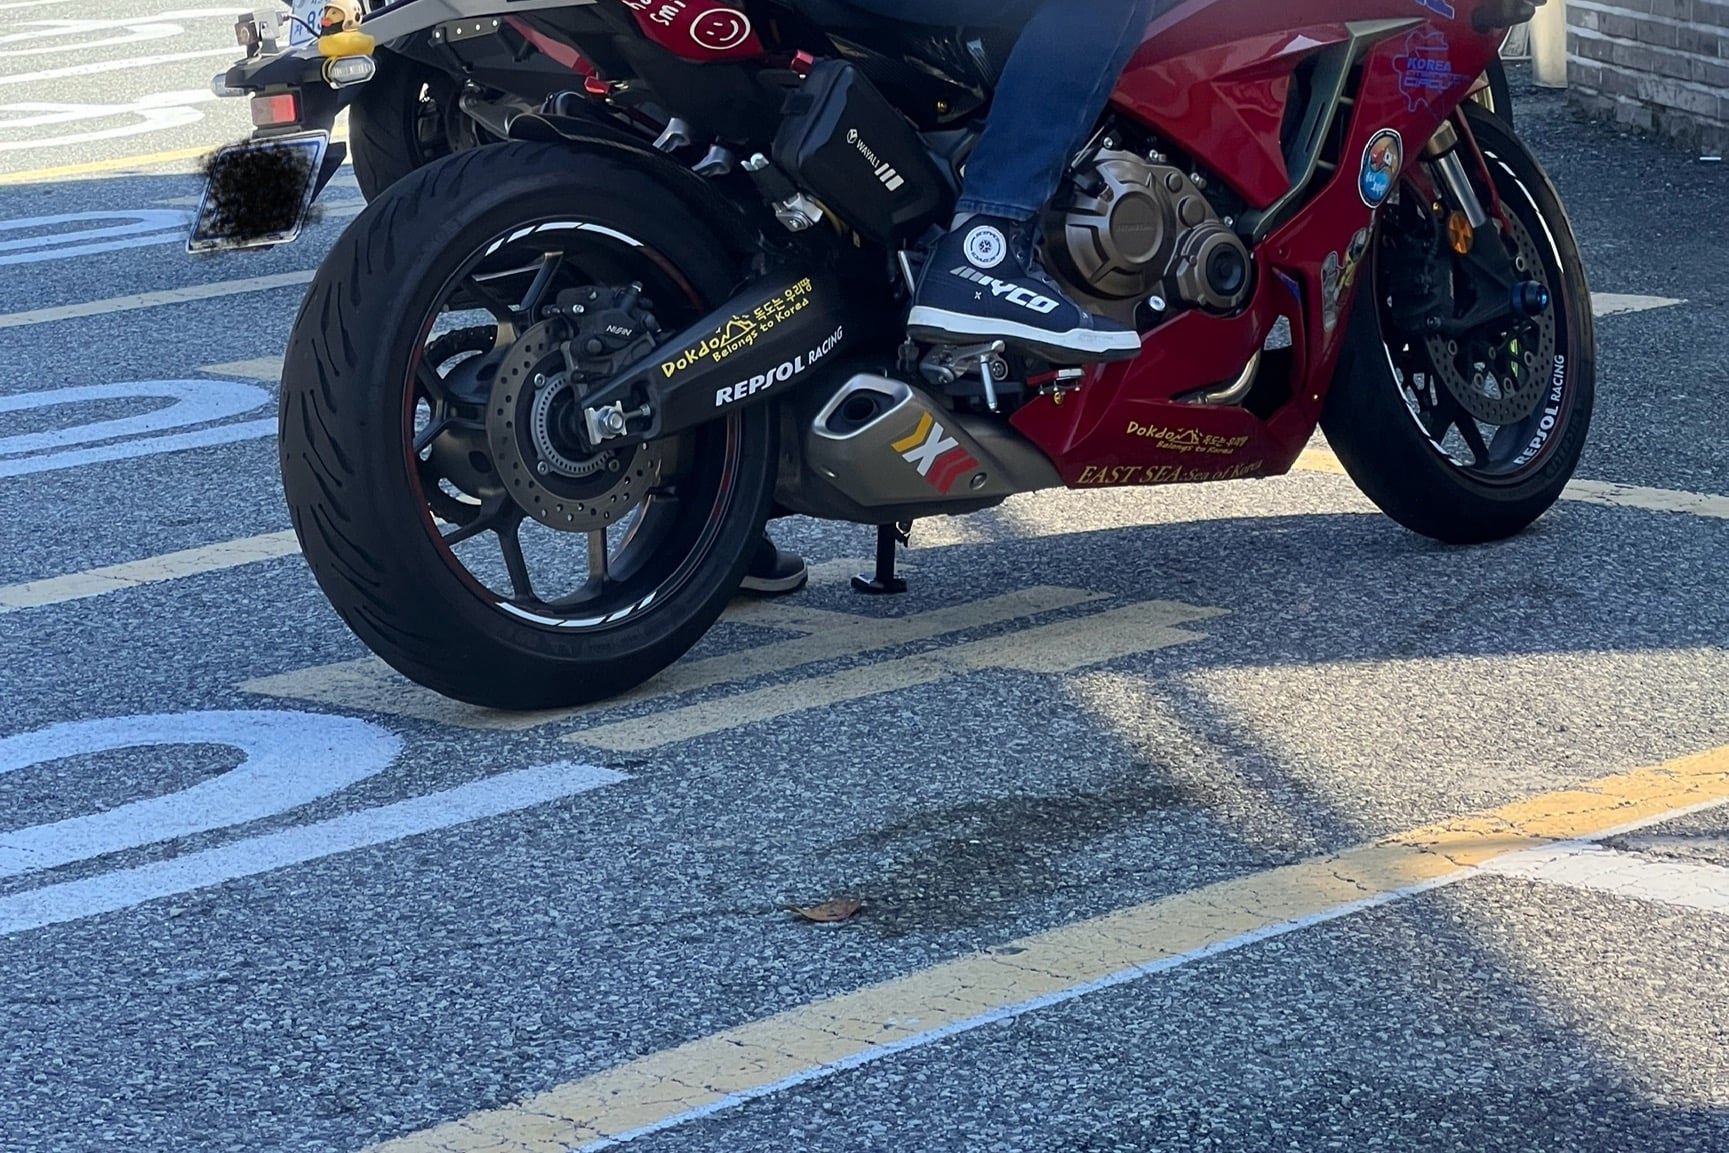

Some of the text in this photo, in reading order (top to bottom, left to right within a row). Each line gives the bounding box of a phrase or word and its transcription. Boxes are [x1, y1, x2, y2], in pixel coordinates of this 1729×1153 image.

[1408, 58, 1451, 72] KOREA
[856, 138, 880, 169] WAYALI
[753, 277, 813, 322] 독도는 우리땅
[712, 298, 809, 363] Belongs to Korea
[661, 336, 720, 378] Dokdo
[715, 325, 844, 407] REPSOL RACING
[1513, 405, 1559, 465] REPSOL
[1550, 354, 1565, 402] RACING
[1126, 421, 1176, 442] Dokdo
[1156, 440, 1192, 454] Belongs
[1077, 465, 1141, 484] EAST
